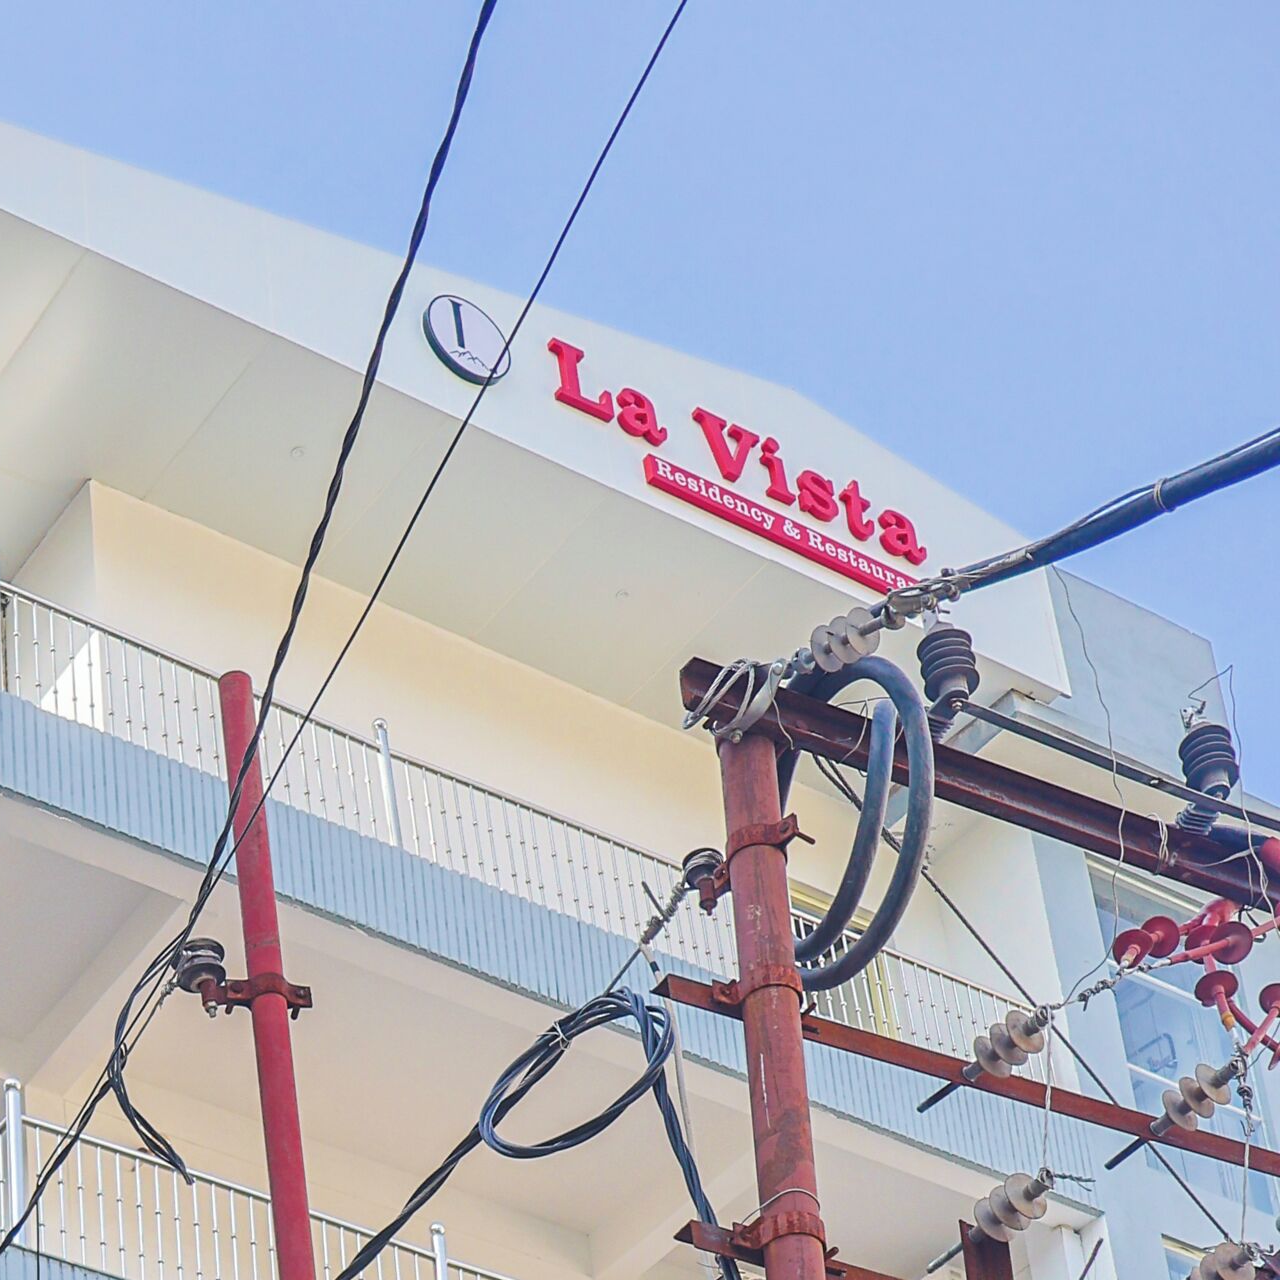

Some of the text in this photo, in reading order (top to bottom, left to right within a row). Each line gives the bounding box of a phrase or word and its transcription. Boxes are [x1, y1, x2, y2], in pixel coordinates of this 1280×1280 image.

[546, 336, 927, 566] La Vista
[655, 458, 916, 589] Residency & Restaura
